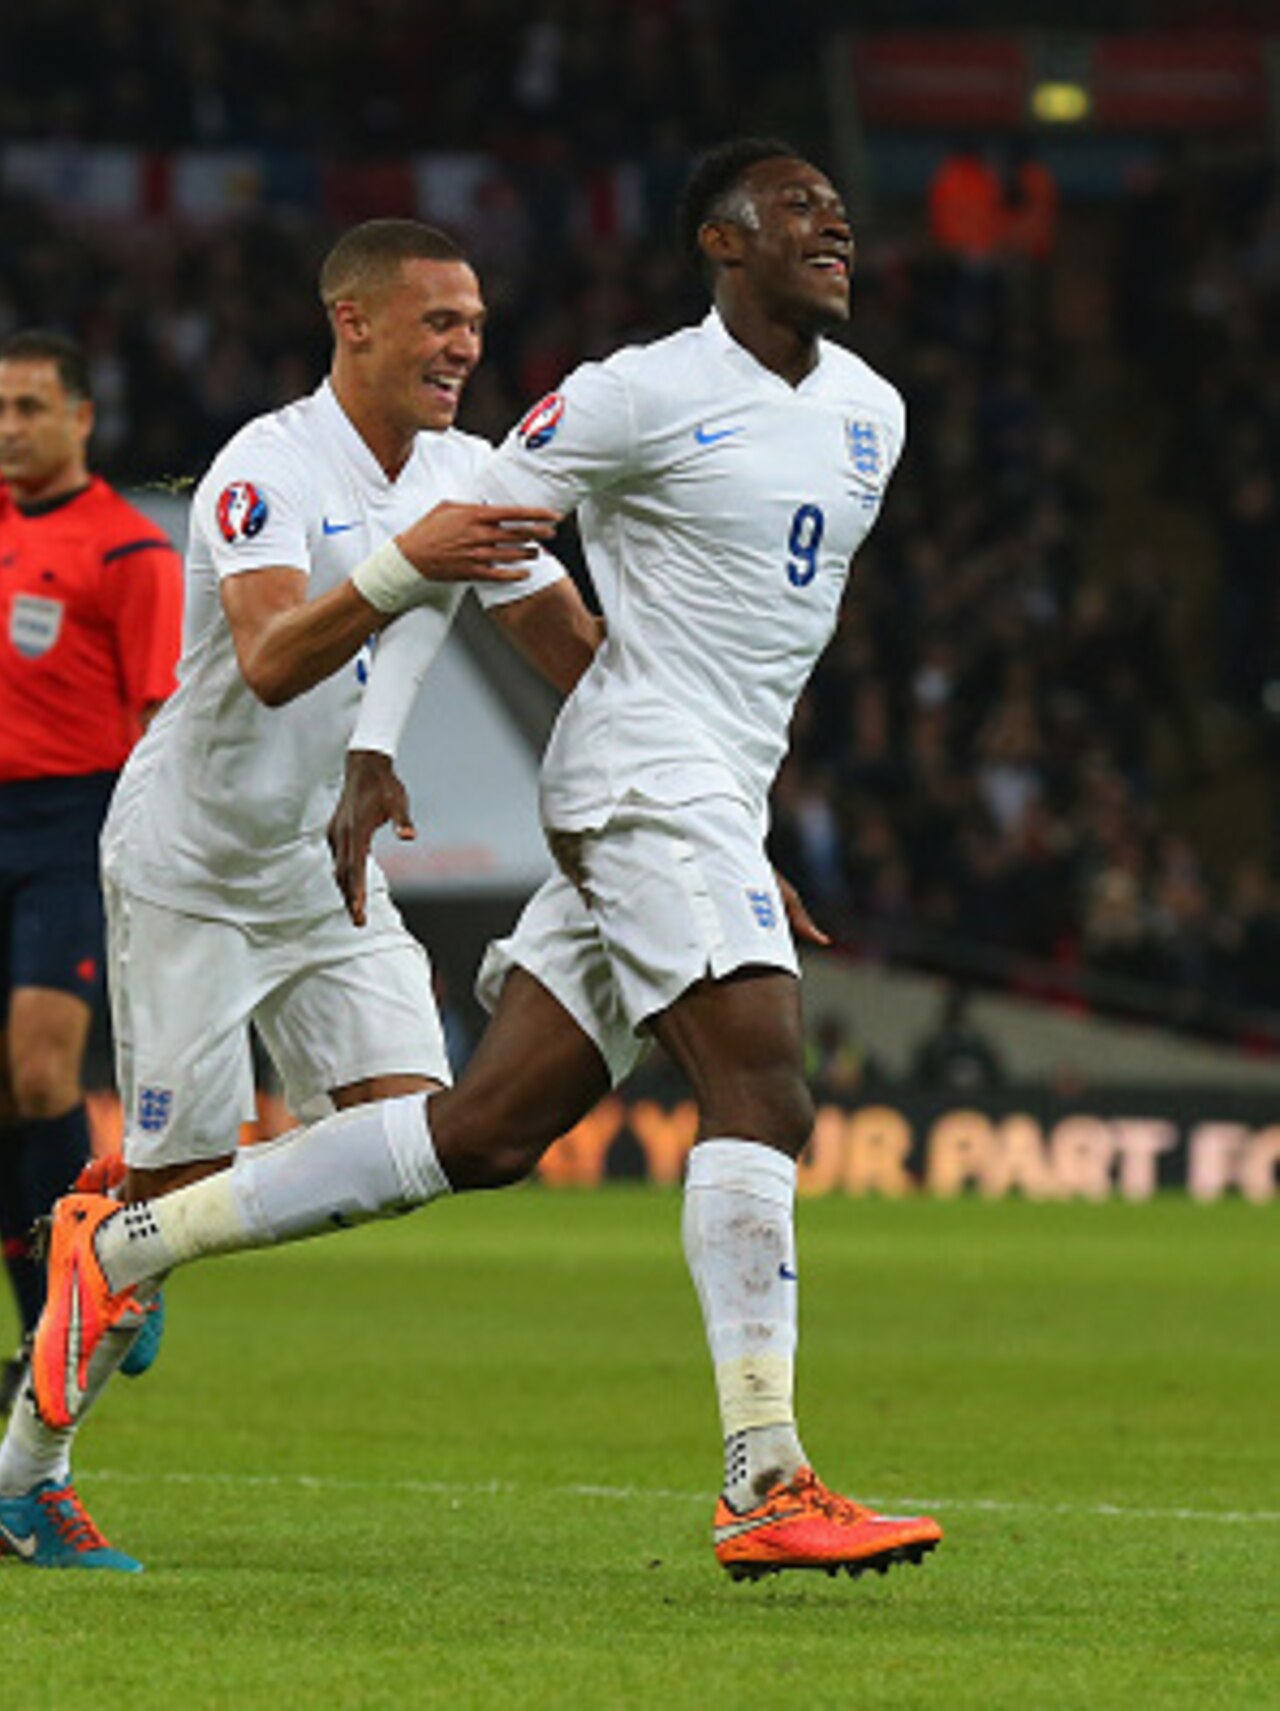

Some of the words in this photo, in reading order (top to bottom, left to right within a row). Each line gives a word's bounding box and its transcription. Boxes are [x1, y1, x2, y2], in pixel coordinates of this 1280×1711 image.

[787, 504, 824, 587] 9
[631, 1096, 911, 1198] YUR
[928, 1110, 1177, 1204] PART
